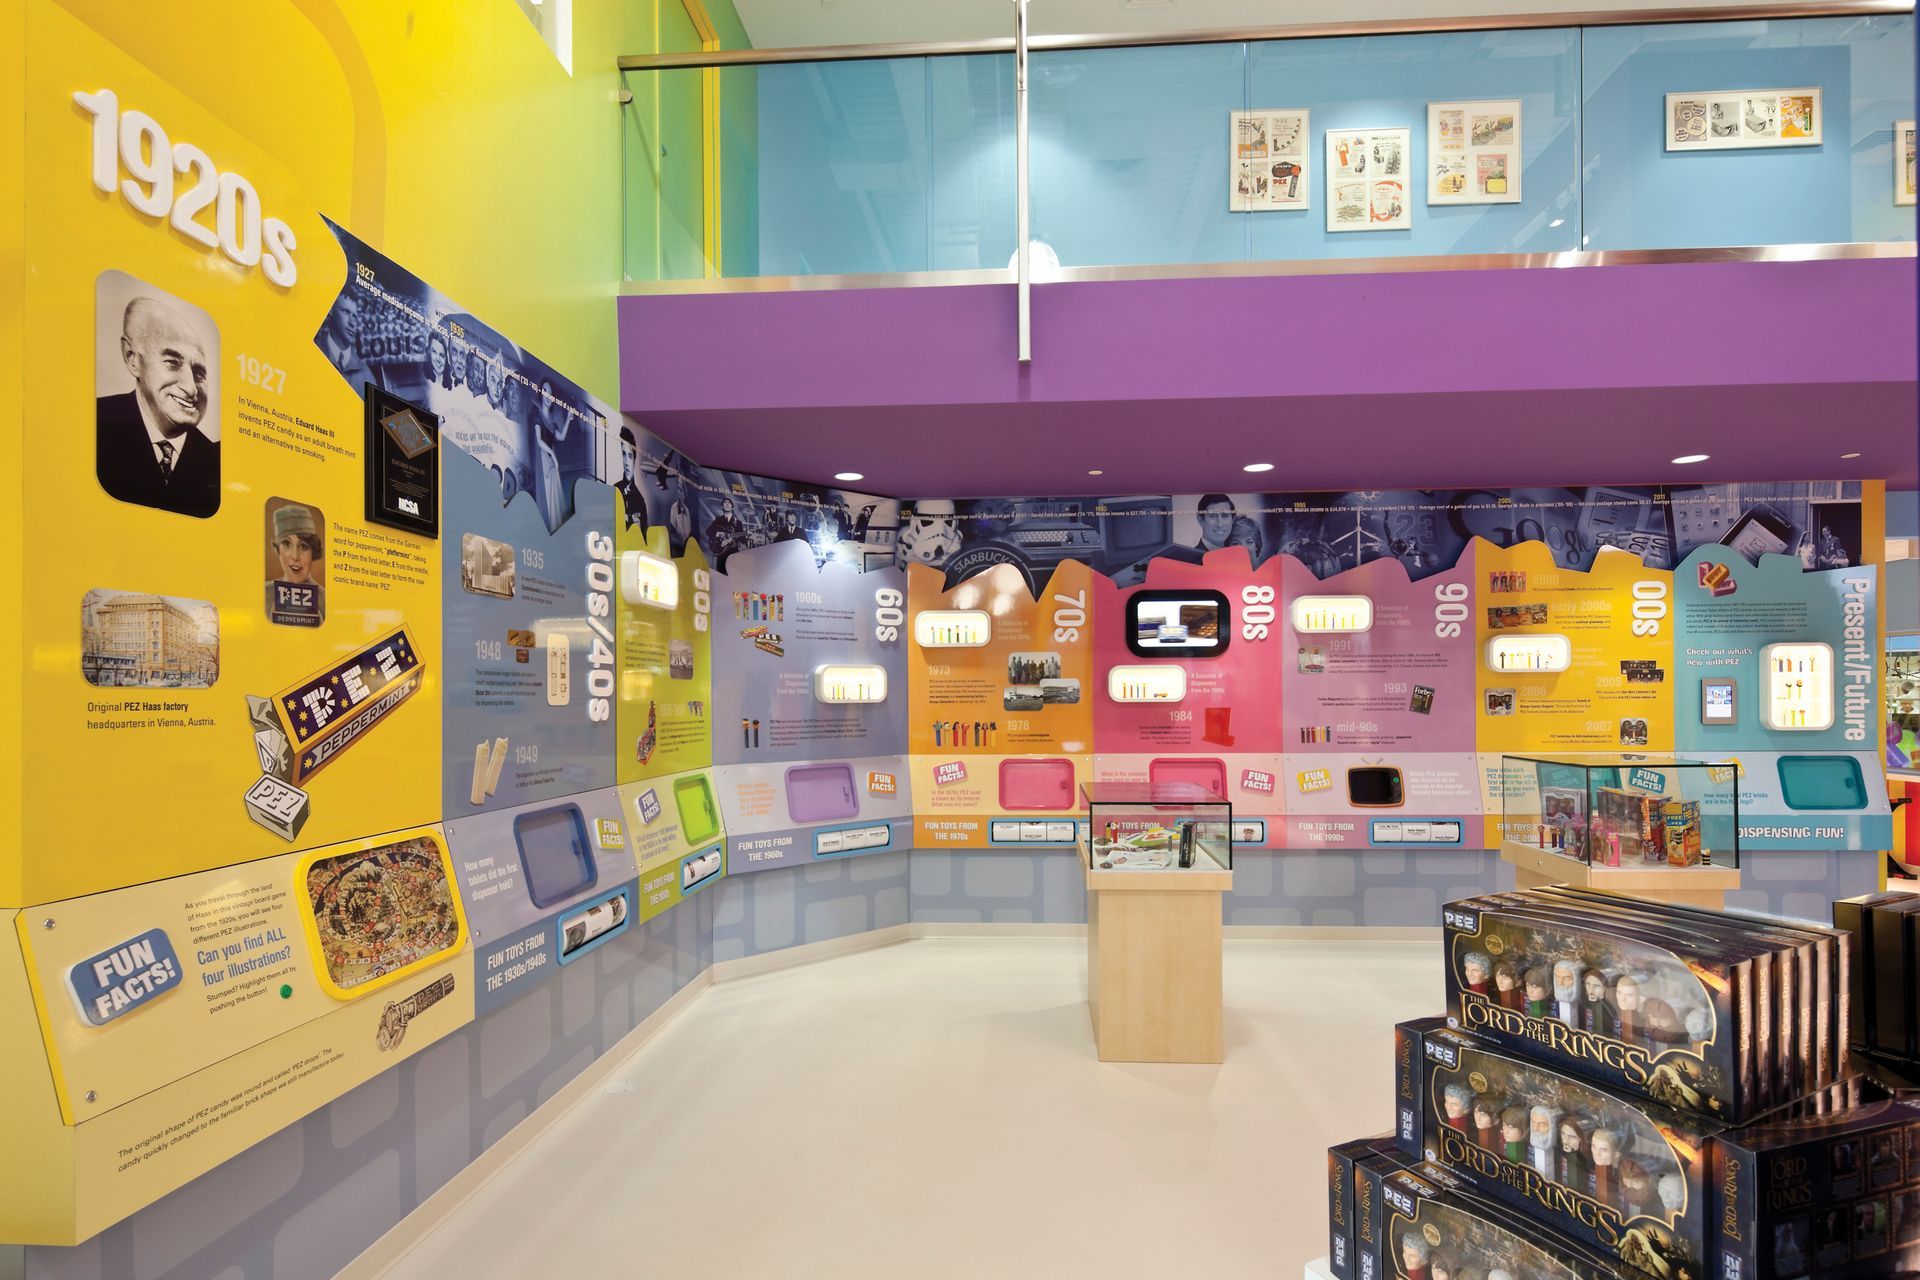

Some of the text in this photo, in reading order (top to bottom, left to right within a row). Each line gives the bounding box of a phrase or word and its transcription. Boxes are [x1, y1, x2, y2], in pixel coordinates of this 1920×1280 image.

[72, 88, 297, 288] 1920s
[356, 262, 375, 282] 1927
[356, 275, 424, 322] Average median income
[450, 320, 464, 338] 1935
[236, 352, 287, 395] 1927
[398, 497, 419, 515] NCSA
[1394, 512, 1442, 546] 23
[521, 548, 544, 570] 1935
[1532, 574, 1559, 585] 2000
[278, 586, 312, 607] PEZ
[694, 568, 710, 632] 50s
[795, 592, 822, 604] 1960s
[876, 588, 903, 642] 60s
[1054, 589, 1086, 643] 70s
[1242, 585, 1275, 640] 80s
[1435, 583, 1468, 638] 90s
[1632, 581, 1667, 636] 00s
[586, 531, 614, 722] 30s/40s
[475, 640, 501, 660] 1948
[1842, 578, 1871, 740] Present/Future
[928, 665, 950, 675] 1973
[302, 646, 402, 728] PEZ
[1384, 683, 1407, 693] 1993
[87, 702, 188, 713] Original PEZ Haas factory
[1170, 711, 1192, 721] 1984
[87, 717, 216, 729] headquarters in Vienna, Austria.
[320, 681, 410, 760] PEPPERMINT
[1007, 720, 1030, 730] 1978
[1336, 722, 1378, 732] mid-90s
[515, 745, 538, 764] 1949
[874, 773, 891, 783] FUN
[938, 771, 964, 784] FACTS!
[940, 764, 959, 774] FUN
[1248, 771, 1269, 782] FUN
[1304, 771, 1324, 781] FUN
[1637, 770, 1659, 782] FUN
[872, 783, 895, 791] FACTS!
[1243, 780, 1271, 791] FACTS!
[1303, 778, 1330, 790] FACTS!
[1632, 778, 1662, 792] FACTS!
[642, 792, 655, 808] FUN
[644, 802, 660, 821] FACTS!
[603, 821, 618, 833] FUN
[1816, 827, 1844, 838] FUN!
[603, 834, 623, 845] FACTS!
[738, 837, 792, 850] FUN TOYS FROM
[1309, 833, 1344, 841] THE 1990s
[464, 857, 494, 872] How many
[748, 850, 783, 861] THE 1960s
[468, 864, 518, 886] tablets did the first
[208, 894, 225, 904] travel
[226, 890, 249, 900] through
[472, 879, 513, 900] dispenser hold?
[195, 910, 211, 919] Haas
[232, 900, 253, 910] vintage
[254, 895, 270, 904] board
[272, 892, 286, 901] game
[218, 915, 237, 924] 1920s,
[1445, 912, 1474, 929] PEZ
[192, 919, 268, 944] different PEZ illustrations.
[197, 928, 286, 965] Can you find ALL
[488, 932, 545, 970] FUN TOYS FROM
[94, 939, 156, 988] FUN
[202, 945, 291, 986] four illustrations?
[486, 953, 546, 992] THE 1930s/1940s
[96, 957, 176, 1019] FACTS!
[1469, 995, 1484, 1004] THE
[1459, 993, 1648, 1085] LORD OF RINGS
[1524, 1029, 1549, 1044] THE
[1425, 1041, 1453, 1064] PEZ
[1403, 1108, 1414, 1140] PEZ
[1399, 1175, 1435, 1197] PEZ
[1437, 1125, 1619, 1246] LORD OF RINGS
[1502, 1174, 1524, 1191] THE
[1384, 1186, 1413, 1213] PEZ
[1723, 1157, 1741, 1241] LORD RINGS
[1336, 1233, 1346, 1266] PEZ
